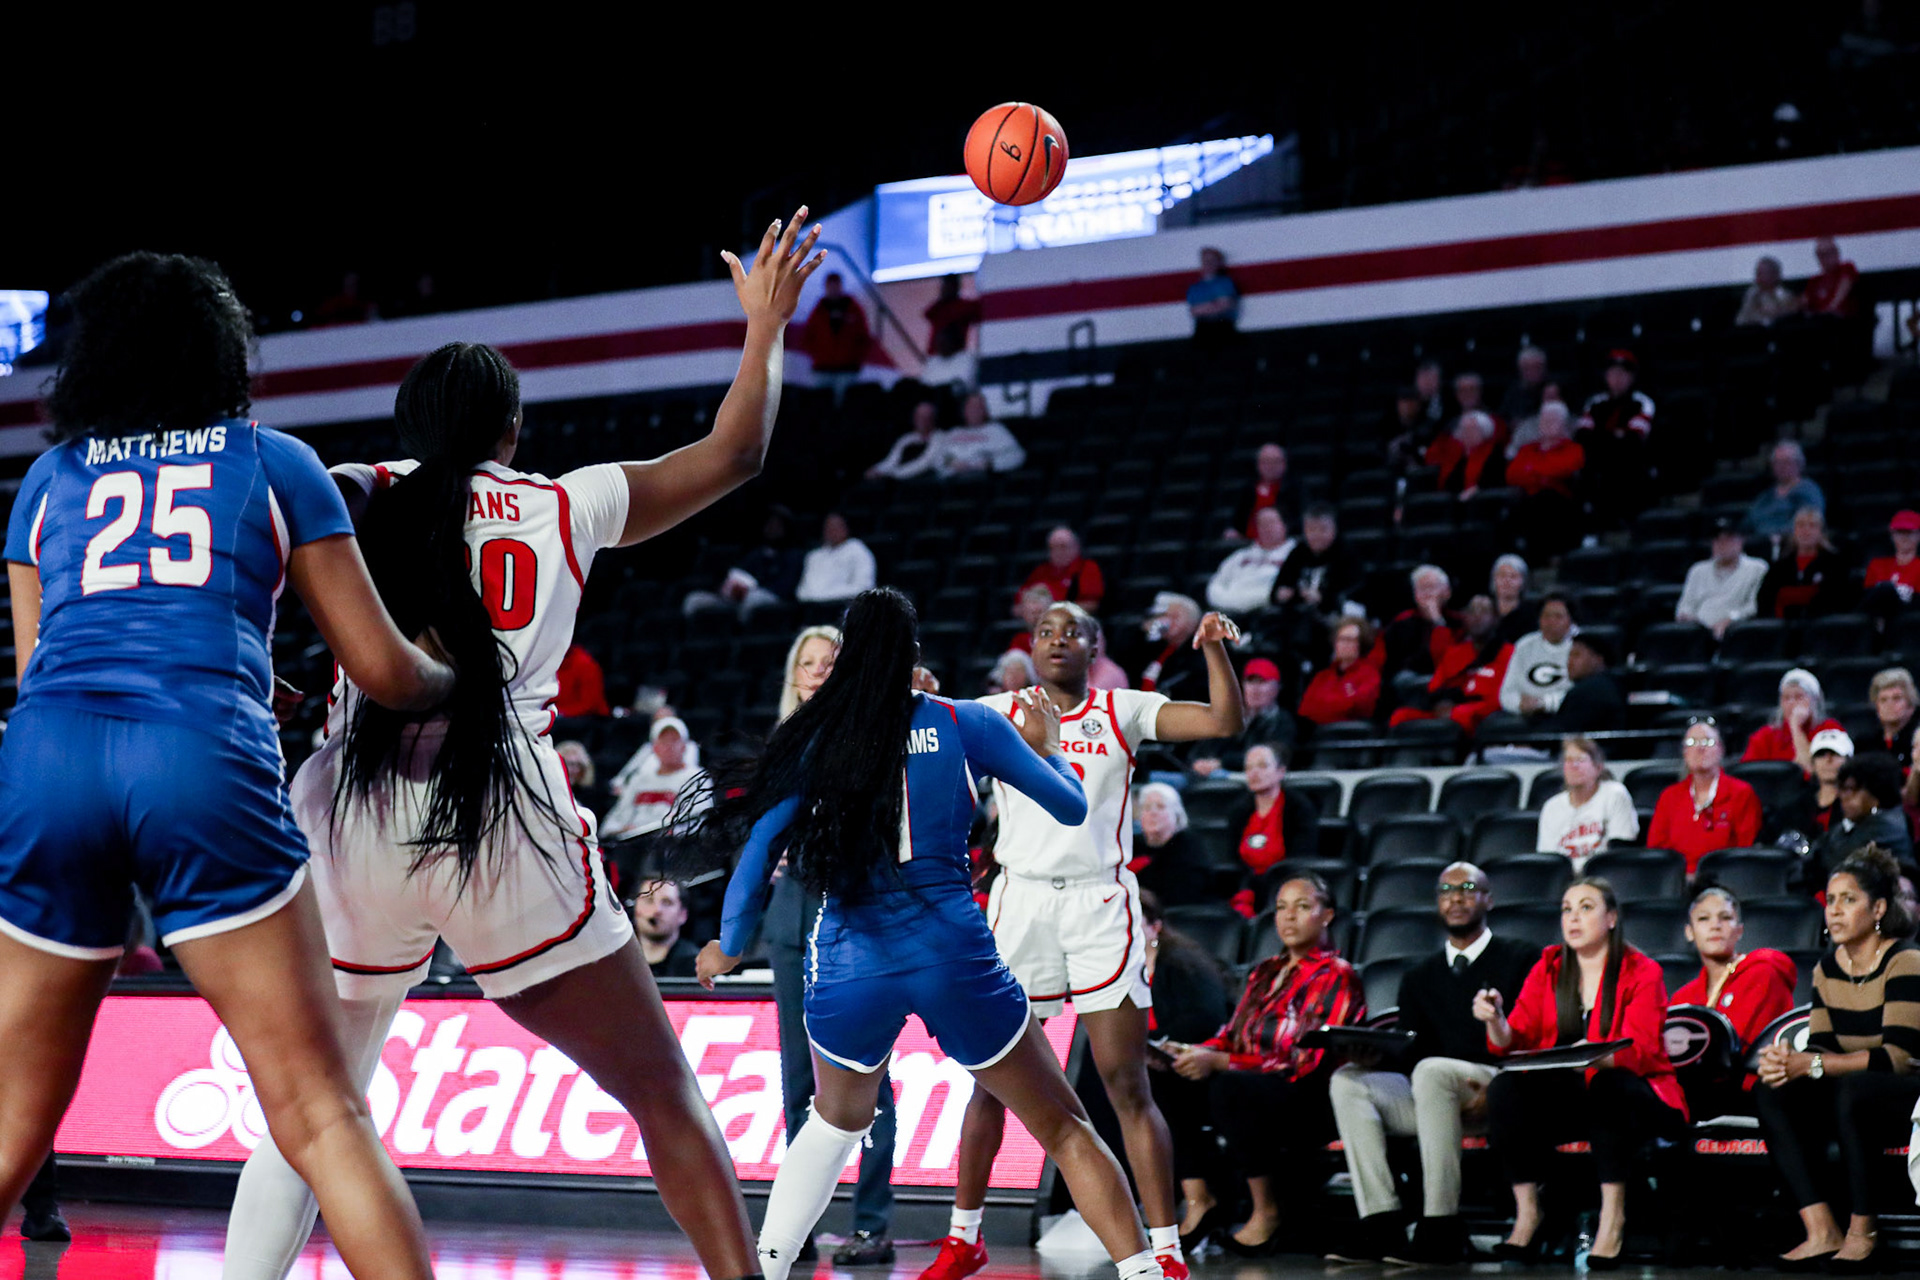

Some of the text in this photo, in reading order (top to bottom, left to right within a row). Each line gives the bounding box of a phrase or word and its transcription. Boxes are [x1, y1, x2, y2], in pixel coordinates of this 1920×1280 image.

[85, 426, 227, 466] MATTHEWS
[468, 490, 521, 522] ANS
[80, 462, 214, 597] 25
[464, 537, 538, 631] 0
[1695, 1138, 1769, 1155] GEORGIA
